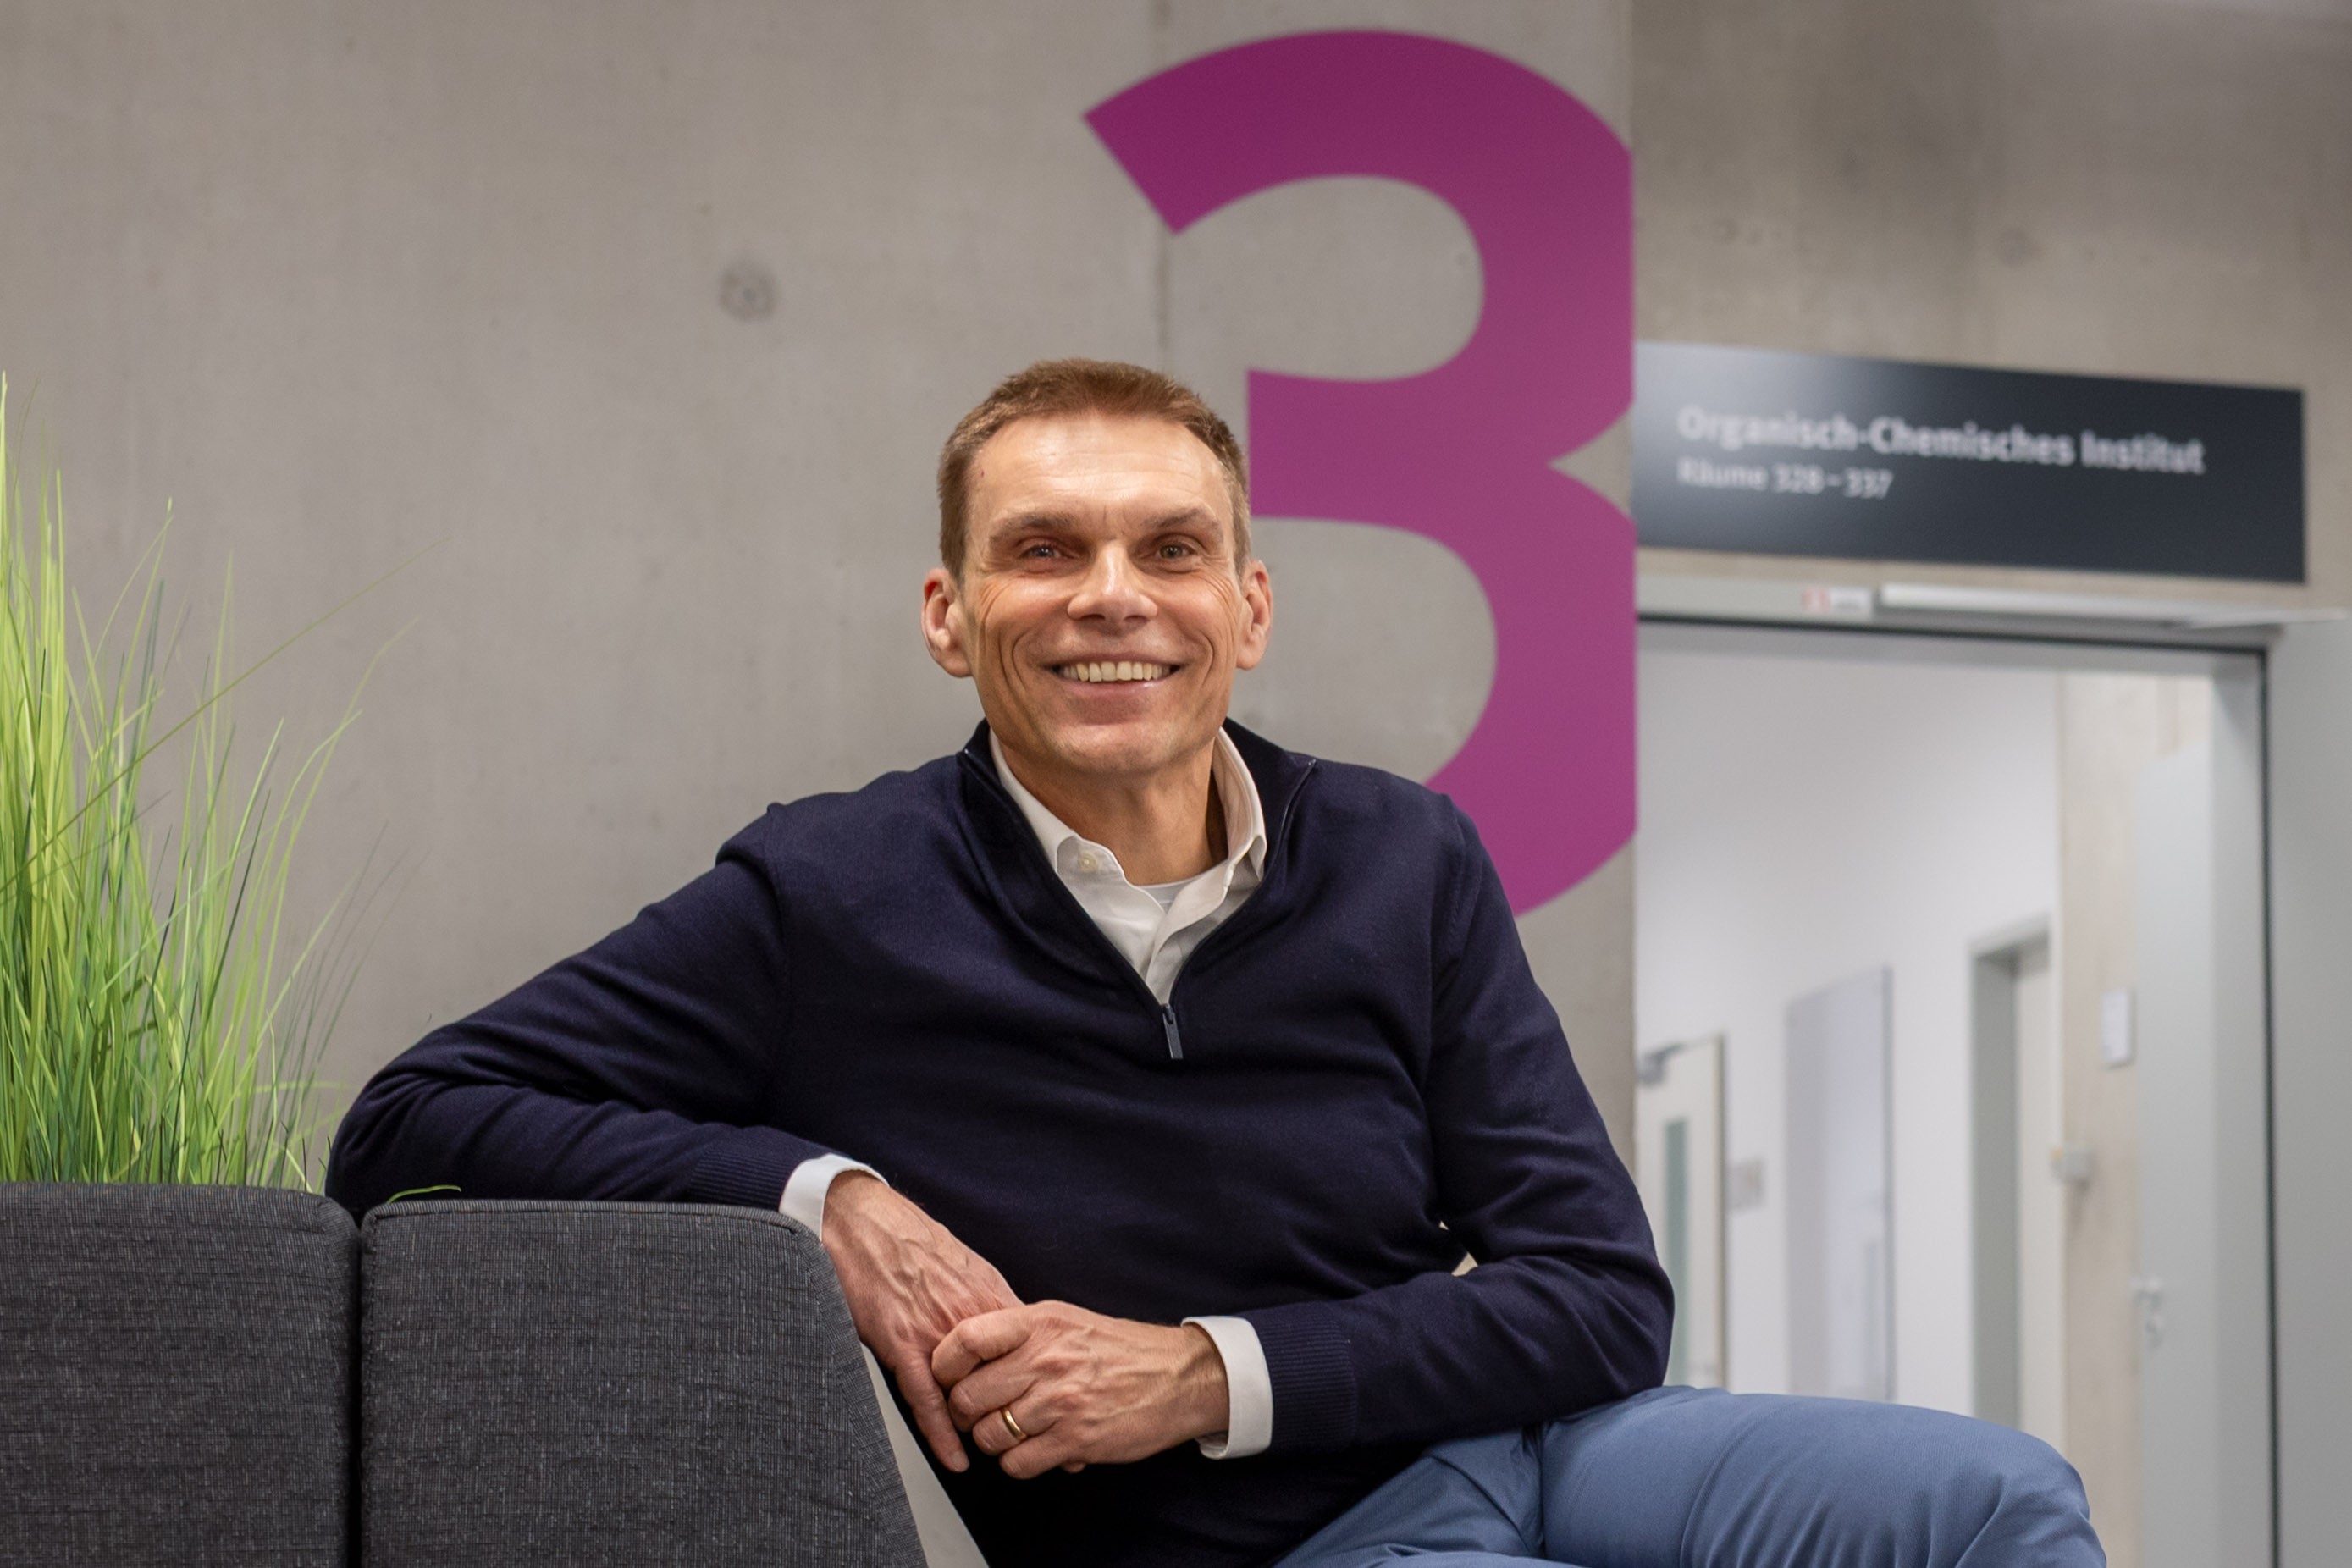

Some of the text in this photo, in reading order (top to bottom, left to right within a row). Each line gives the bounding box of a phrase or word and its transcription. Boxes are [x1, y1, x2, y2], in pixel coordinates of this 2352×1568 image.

[1084, 29, 1636, 918] 3
[1677, 405, 2206, 475] Organisch-Chemisches Institut
[1677, 457, 1769, 490] Räume
